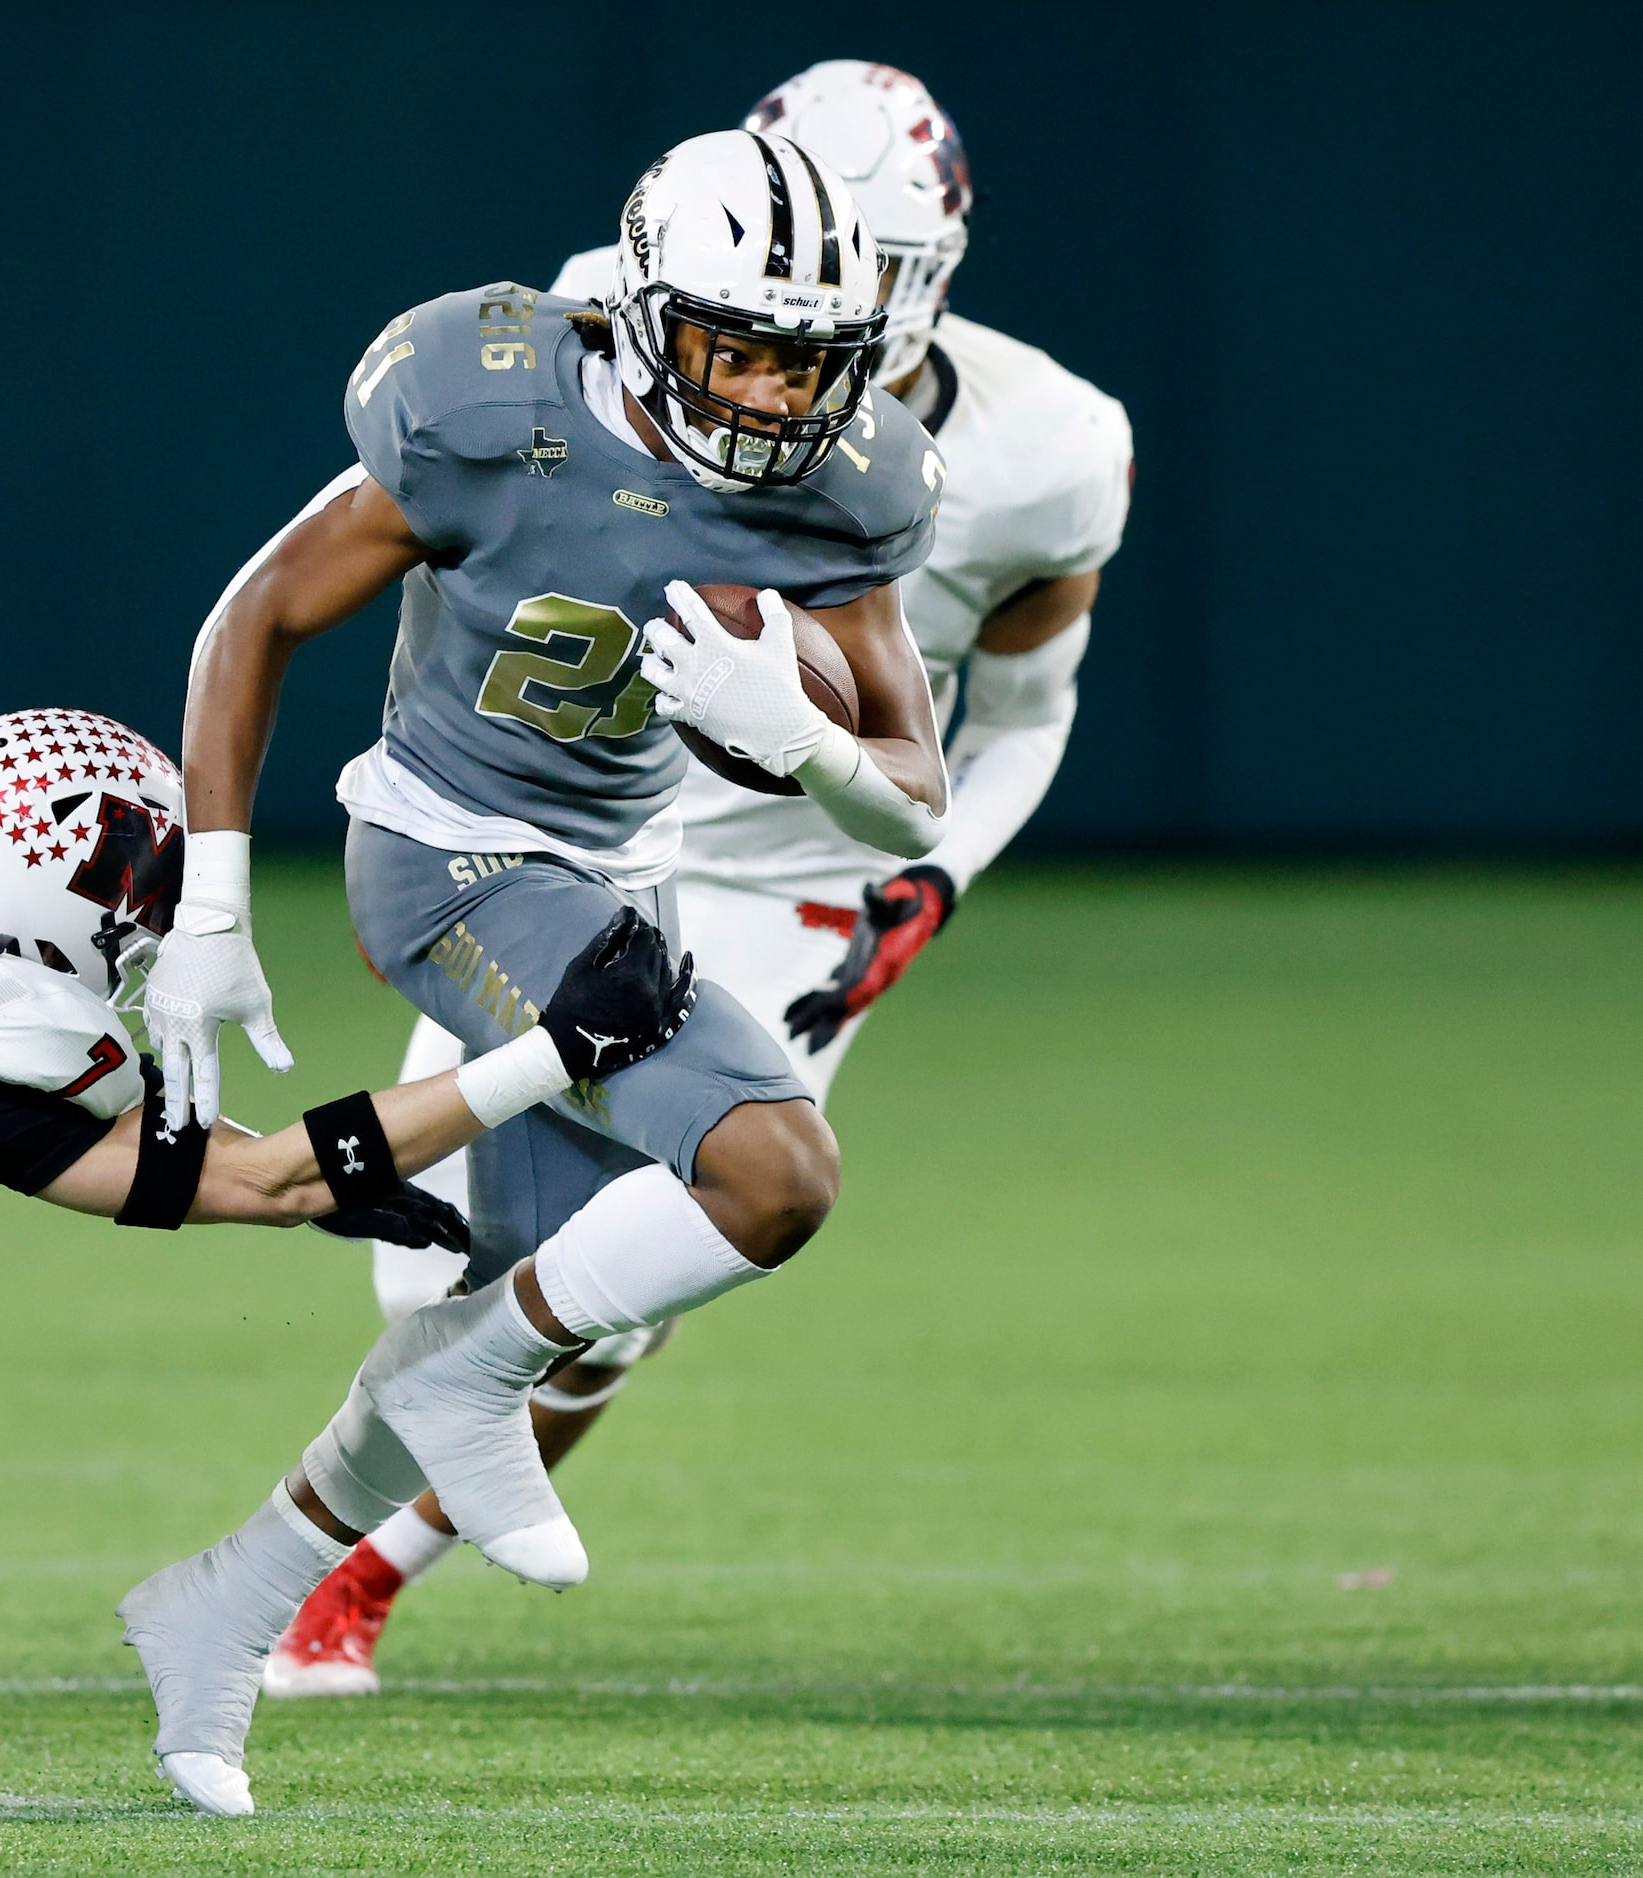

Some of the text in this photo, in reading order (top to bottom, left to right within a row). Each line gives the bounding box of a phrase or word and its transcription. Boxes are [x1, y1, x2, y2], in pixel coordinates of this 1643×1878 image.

[617, 492, 666, 514] BATTLE
[66, 791, 184, 937] M
[62, 1032, 127, 1099] 7
